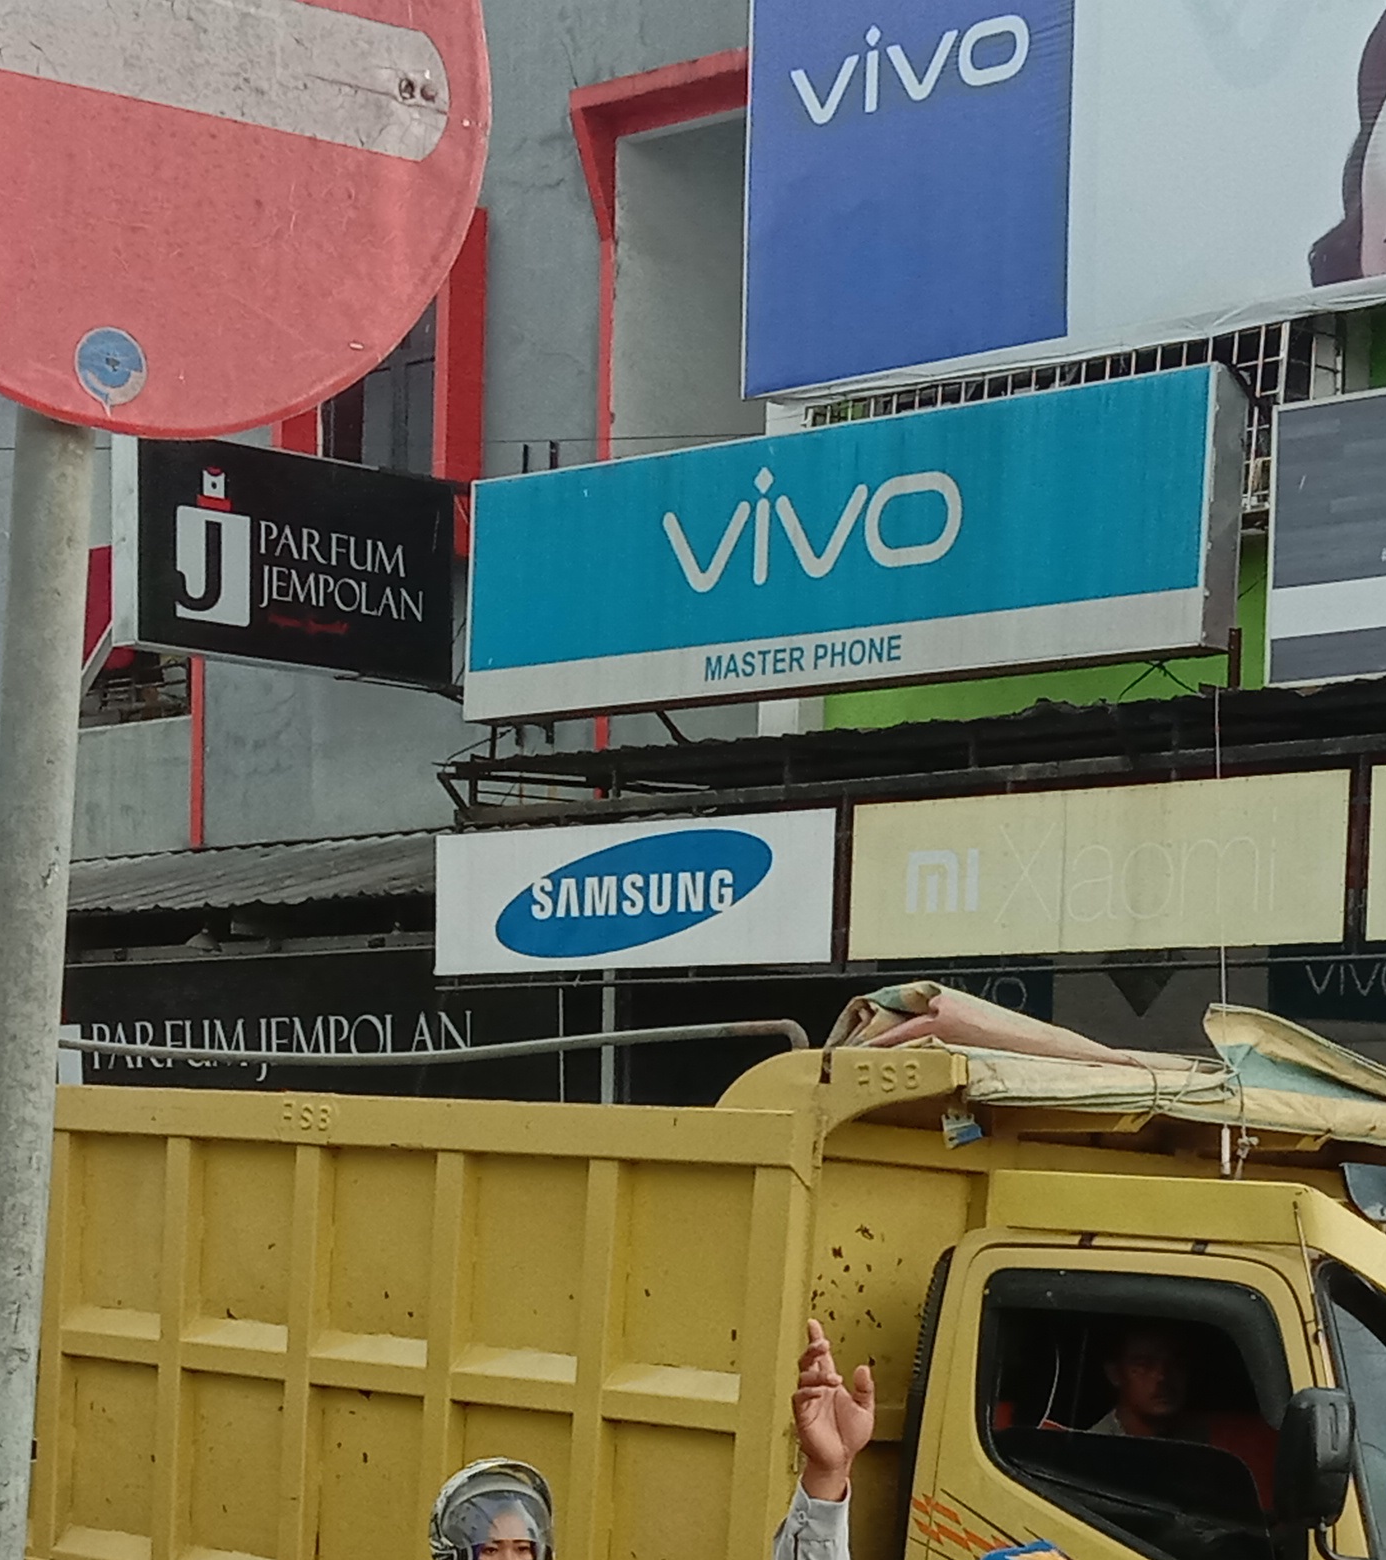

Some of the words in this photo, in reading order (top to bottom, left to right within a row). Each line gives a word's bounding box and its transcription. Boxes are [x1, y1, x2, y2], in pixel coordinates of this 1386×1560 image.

[791, 14, 1030, 125] vivo
[259, 520, 406, 578] PARFUM
[663, 467, 963, 592] vivo
[259, 564, 424, 623] JEMPOLAN
[705, 644, 805, 682] MASTER
[813, 634, 903, 673] PHONE
[530, 868, 735, 920] SAMSUNG
[994, 806, 1278, 924] Xiaomi
[92, 1018, 248, 1070] PARFUM
[256, 1009, 474, 1082] JEMPOLAN
